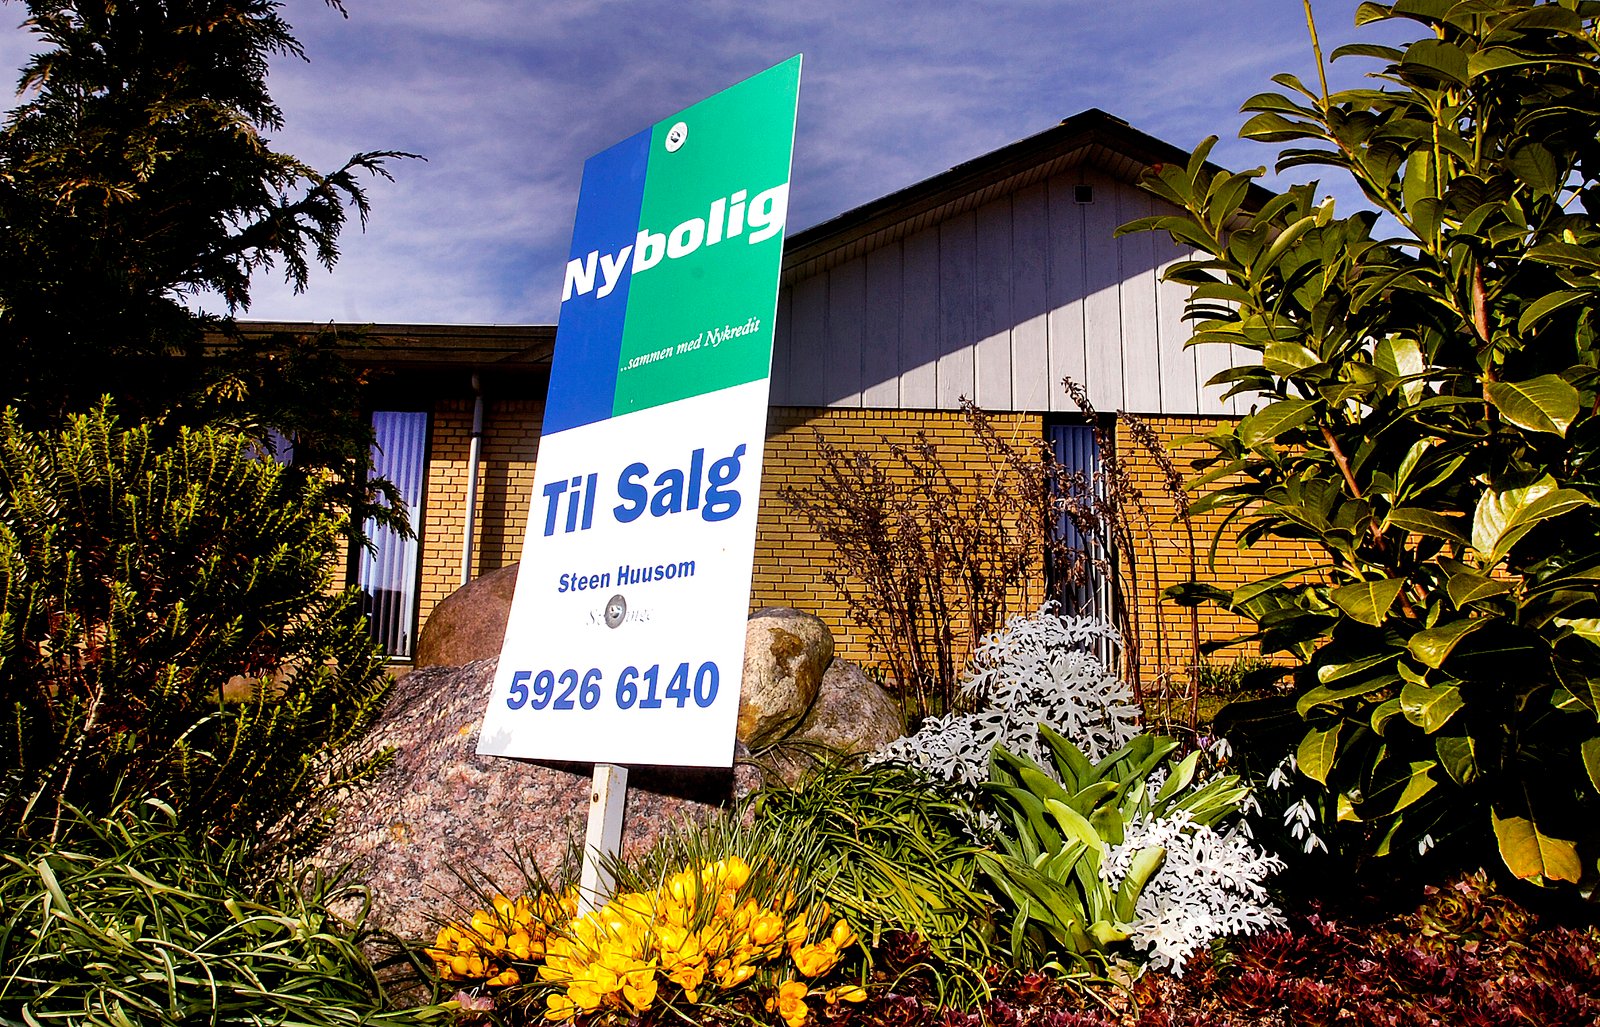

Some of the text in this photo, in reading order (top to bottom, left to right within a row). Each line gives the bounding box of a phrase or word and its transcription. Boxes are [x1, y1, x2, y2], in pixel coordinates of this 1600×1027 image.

[561, 182, 789, 303] Nybolig
[676, 333, 703, 355] med
[704, 316, 761, 348] Nykredit
[542, 443, 747, 537] Til Salg
[558, 560, 696, 593] Steen Huusom
[506, 661, 720, 711] 5926 6140
